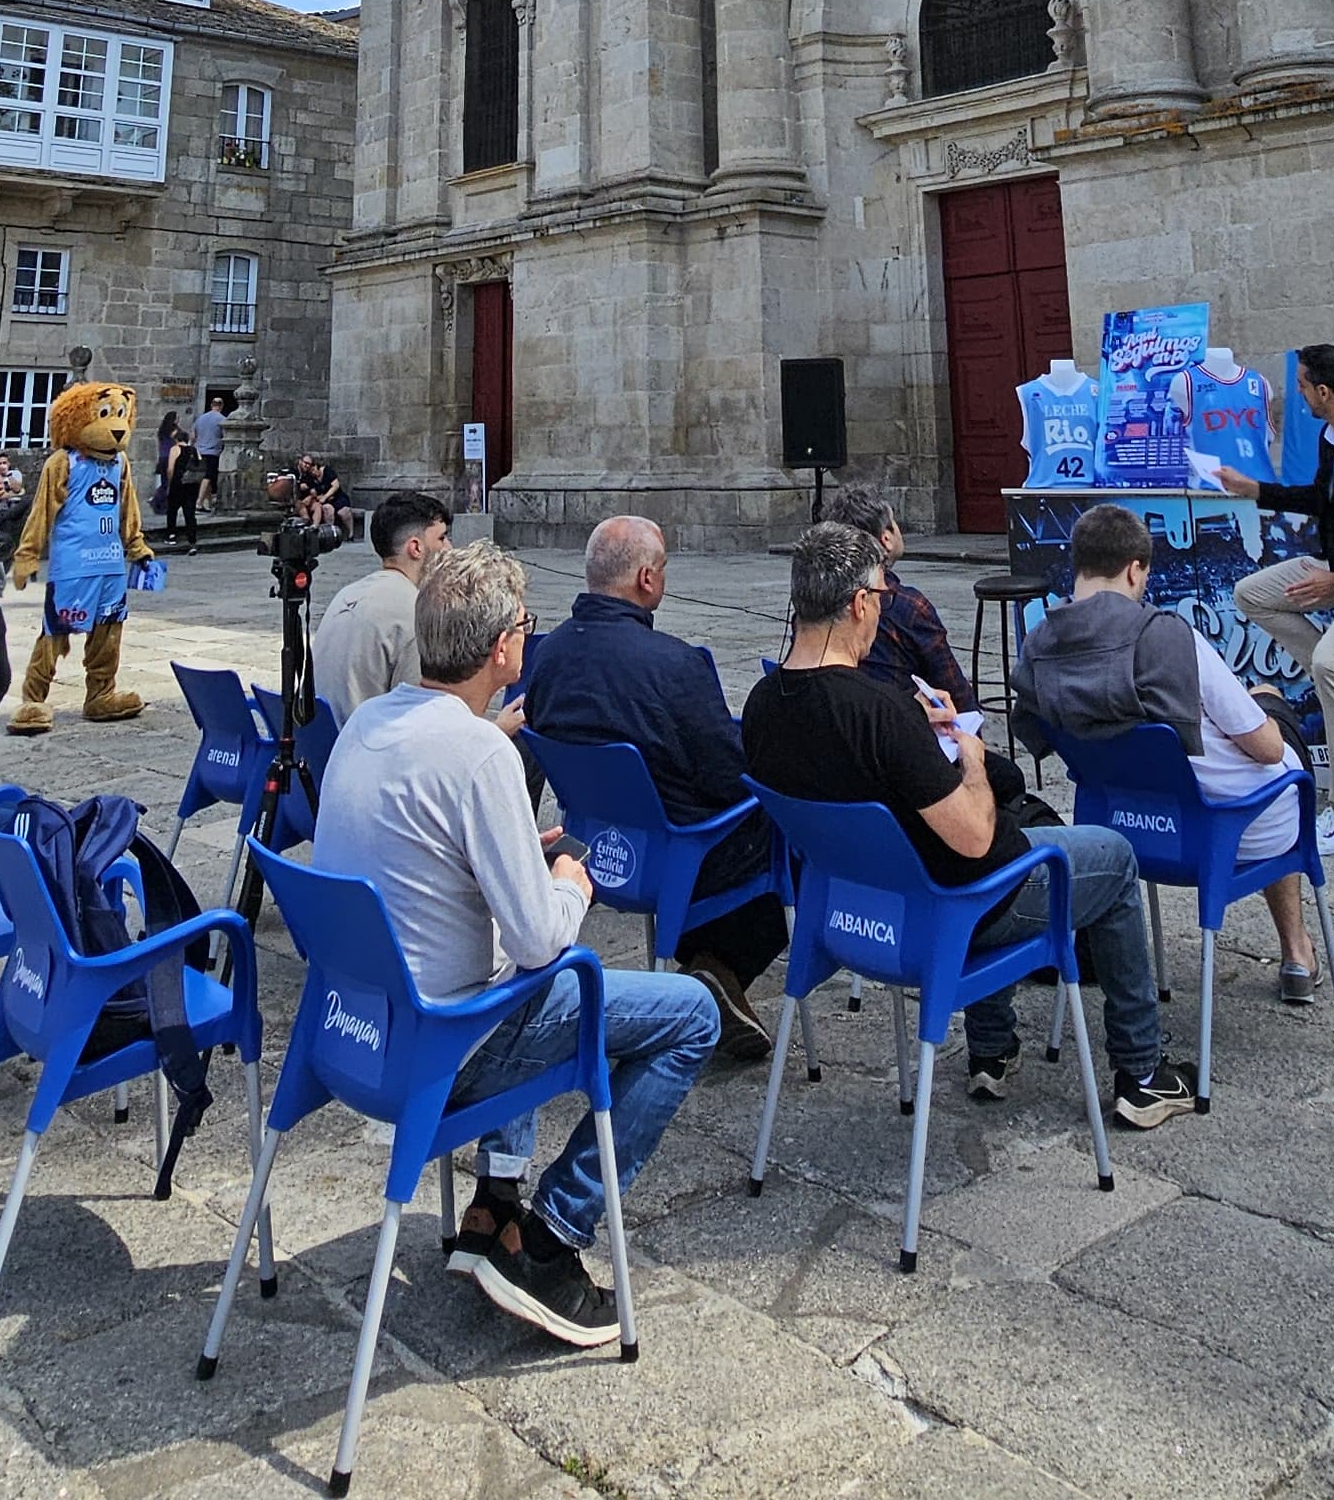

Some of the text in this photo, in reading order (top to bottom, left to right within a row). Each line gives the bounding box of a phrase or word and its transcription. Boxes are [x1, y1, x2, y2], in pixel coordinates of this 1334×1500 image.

[1111, 335, 1201, 372] Seguimos
[1044, 404, 1089, 417] LECHE
[1203, 408, 1260, 432] DYC
[1236, 438, 1254, 458] 13
[1056, 457, 1085, 478] 42
[99, 516, 113, 535] 00
[208, 749, 240, 767] arenal
[596, 840, 628, 861] Estrella
[595, 854, 624, 875] Galicia
